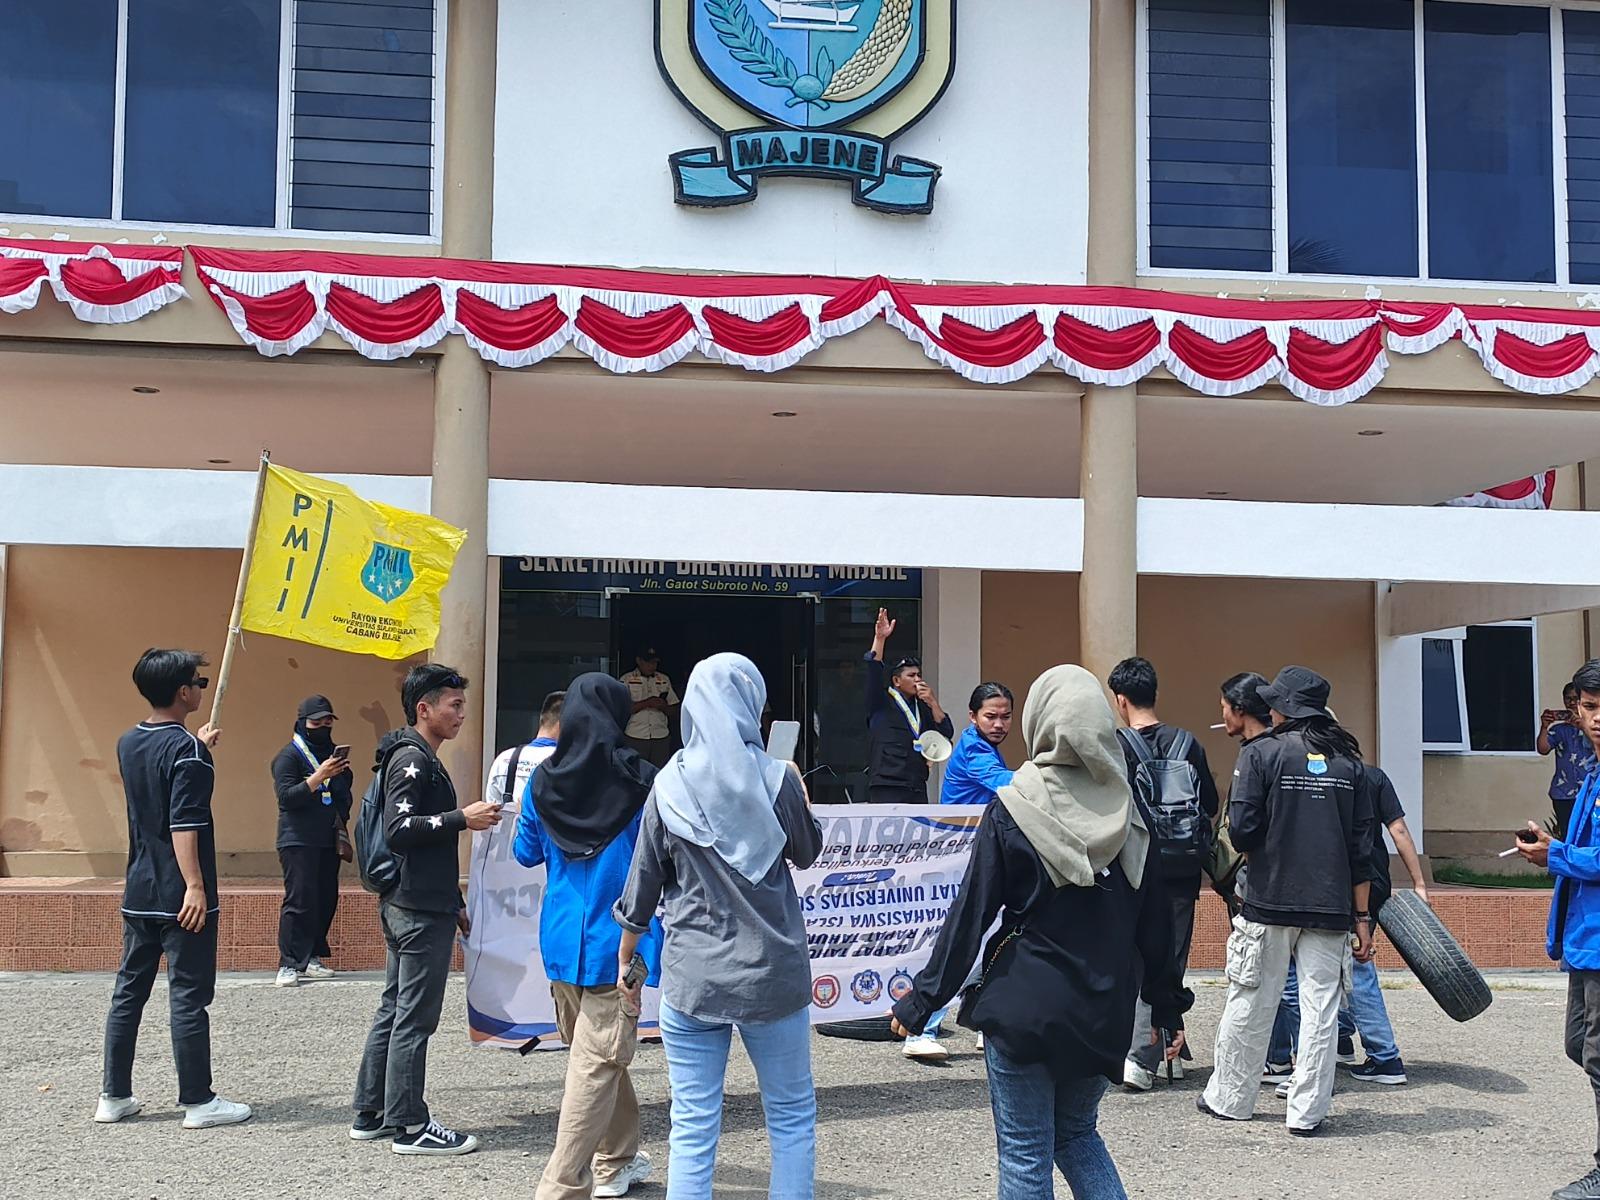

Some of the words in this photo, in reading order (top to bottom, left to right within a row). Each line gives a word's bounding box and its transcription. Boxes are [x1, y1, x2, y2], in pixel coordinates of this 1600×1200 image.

[736, 137, 878, 171] MAJENE
[640, 578, 661, 589] Jln.
[665, 578, 698, 590] Gatot
[701, 579, 748, 591] Subroto
[751, 581, 770, 592] No.
[774, 581, 789, 592] 59
[332, 615, 376, 630] UNIVERSITAS
[351, 611, 377, 624] RAYON
[345, 625, 380, 639] CABANG
[857, 843, 901, 855] Dalam
[908, 841, 942, 850] Loyal
[812, 857, 892, 870] Berkualitas
[820, 885, 925, 910] UNIVERSITAS
[850, 907, 951, 928] MAHASISWA
[865, 927, 919, 942] RAPAT
[851, 943, 908, 957] RAPAT
